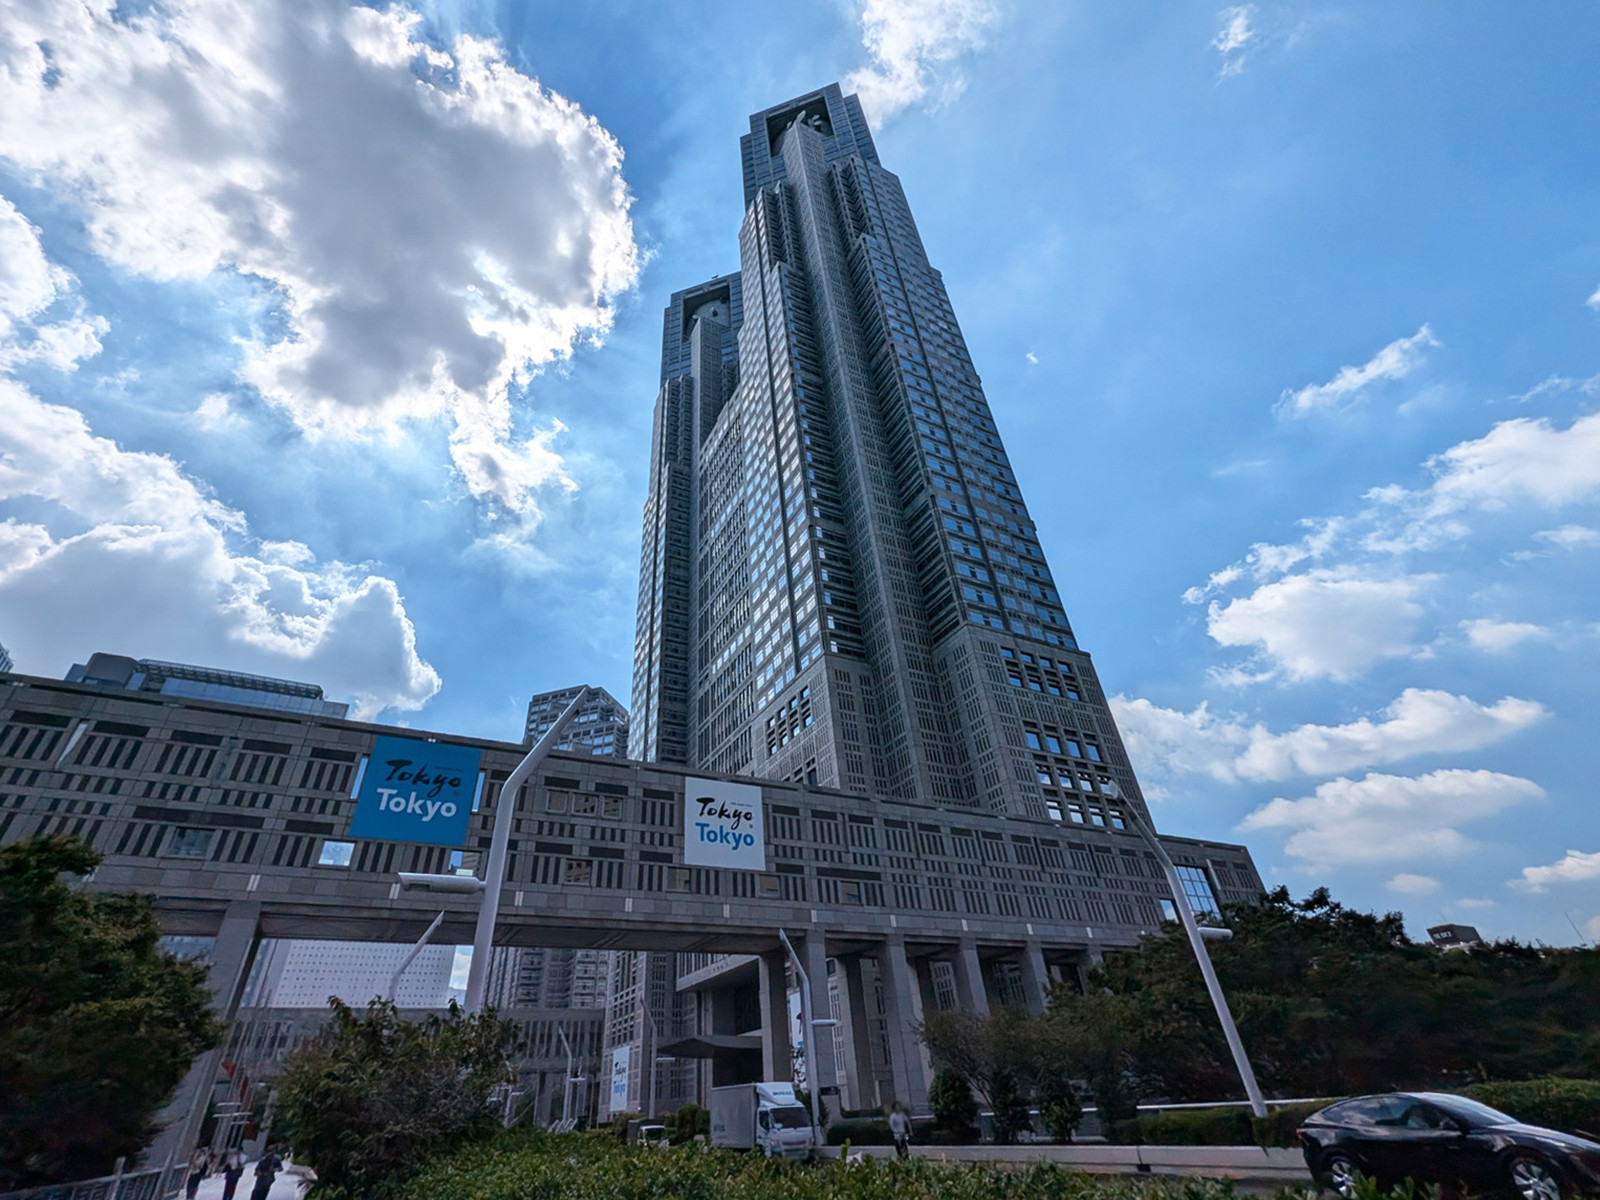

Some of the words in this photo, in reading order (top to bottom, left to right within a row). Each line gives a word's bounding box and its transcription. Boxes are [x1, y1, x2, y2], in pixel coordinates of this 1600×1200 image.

[385, 759, 461, 798] Tokyo
[376, 787, 457, 822] Tokyo
[695, 797, 753, 830] Tokyo
[695, 822, 754, 851] Tokyo
